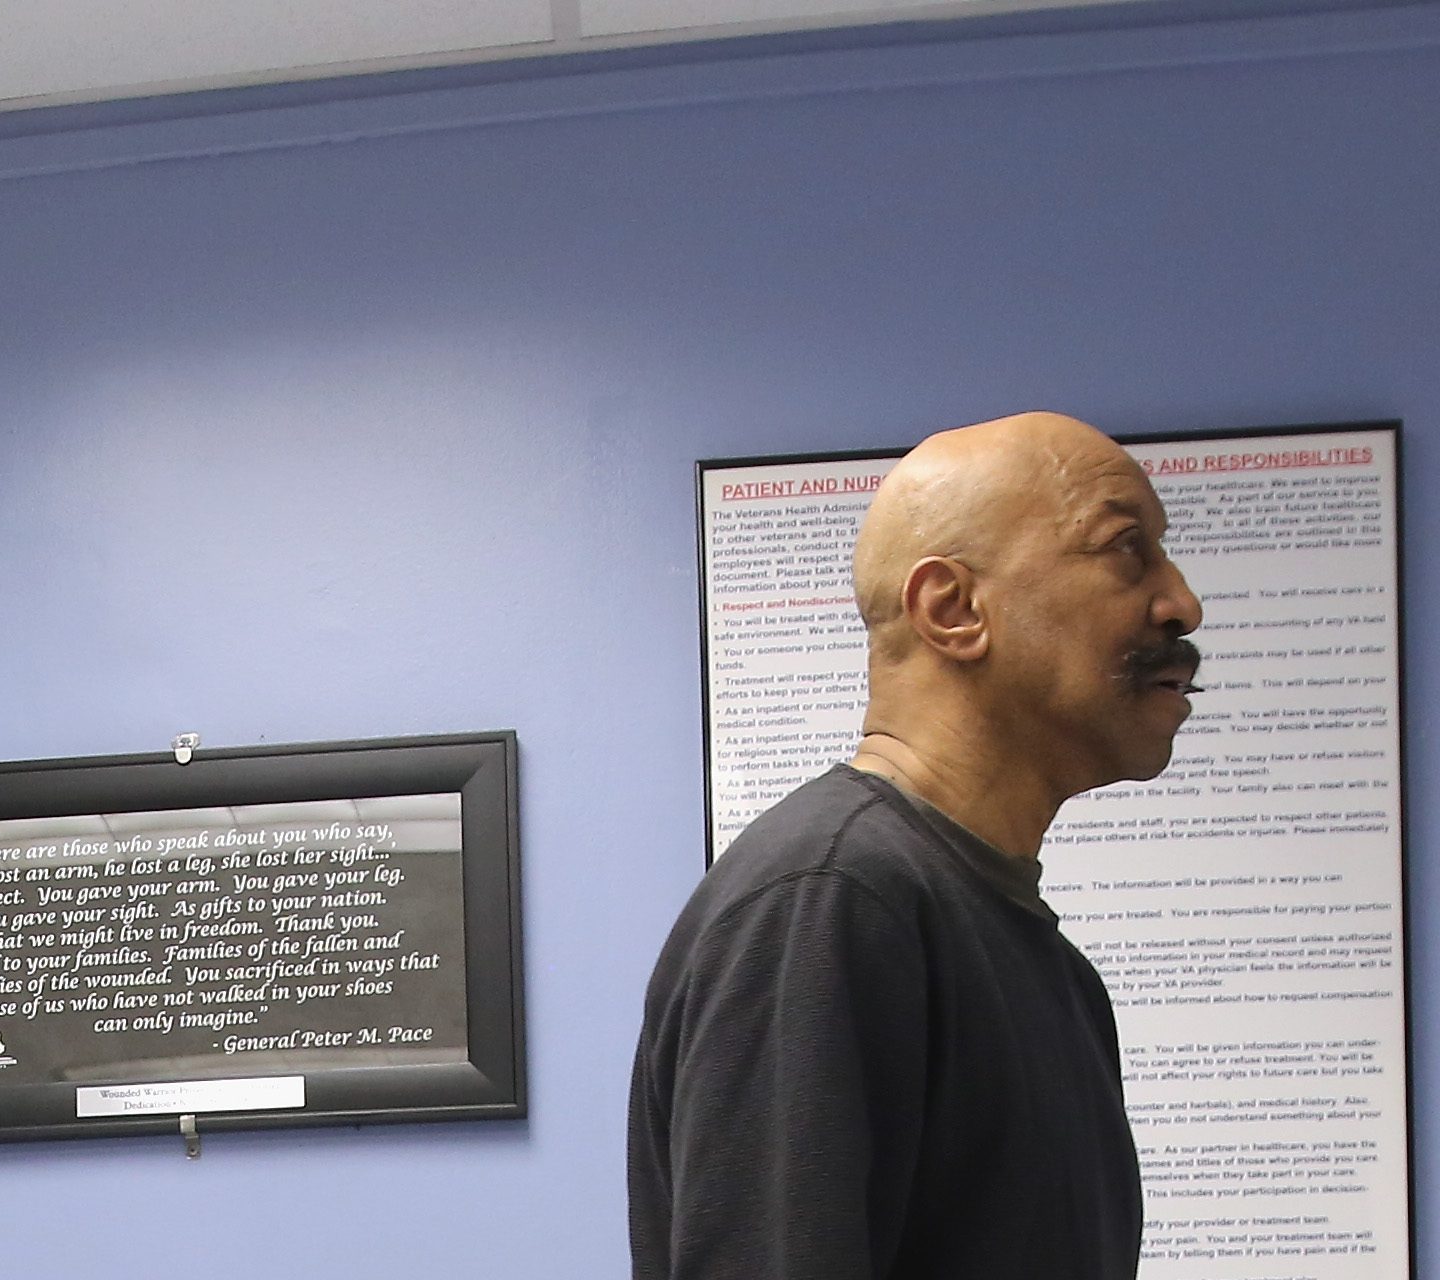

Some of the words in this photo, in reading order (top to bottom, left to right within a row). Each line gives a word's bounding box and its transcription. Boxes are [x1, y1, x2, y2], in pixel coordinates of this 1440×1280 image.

[1160, 456, 1197, 473] AND
[1204, 446, 1373, 471] RESPONSIBILITIES
[722, 480, 794, 498] PATIENT
[799, 478, 837, 493] AND
[844, 474, 883, 489] NUR
[26, 845, 56, 858] are
[63, 838, 108, 856] those
[113, 834, 151, 852] who
[156, 830, 208, 855] speak
[213, 828, 266, 846] about
[272, 829, 306, 848] you
[311, 822, 350, 840] who
[355, 824, 392, 842] say,
[25, 868, 50, 881] an
[55, 865, 98, 879] arm,
[104, 858, 125, 876] he
[130, 856, 162, 874] lost
[167, 860, 180, 872] a
[185, 853, 215, 875] leg,
[220, 850, 250, 869] she
[256, 849, 288, 866] lost
[293, 846, 325, 864] her
[37, 886, 73, 905] You
[76, 885, 121, 905] gave
[126, 882, 172, 902] your
[176, 879, 219, 893] arm.
[232, 874, 269, 893] You
[272, 873, 318, 893] gave
[323, 870, 369, 890] your
[374, 863, 404, 886] leg.
[10, 911, 56, 931] gave
[61, 908, 106, 928] your
[109, 900, 158, 920] sight.
[170, 900, 196, 916] As
[199, 895, 242, 920] gifts
[247, 897, 265, 911] to
[271, 895, 316, 916] your
[320, 889, 386, 907] nation.
[27, 934, 54, 946] we
[59, 925, 114, 945] might
[124, 925, 153, 941] live
[159, 923, 179, 939] in
[178, 917, 262, 944] freedom.
[274, 911, 334, 932] Thank
[339, 914, 378, 934] you.
[3, 956, 20, 970] to
[25, 955, 71, 975] your
[72, 946, 151, 972] families.
[162, 940, 242, 964] Families
[247, 937, 269, 961] of
[271, 936, 299, 954] the
[300, 933, 358, 958] fallen
[363, 929, 404, 949] and
[27, 973, 48, 996] of
[51, 971, 78, 990] the
[83, 965, 172, 987] wounded.
[184, 966, 220, 985] You
[224, 957, 320, 980] sacrificed
[321, 958, 340, 974] in
[345, 958, 394, 977] ways
[400, 951, 439, 969] that
[21, 995, 42, 1019] of
[43, 999, 64, 1012] us
[69, 992, 107, 1010] who
[112, 990, 157, 1008] have
[162, 990, 194, 1005] not
[198, 982, 271, 1003] walked
[271, 983, 290, 999] in
[295, 983, 341, 1004] your
[344, 977, 393, 995] shoes
[93, 1018, 128, 1032] can
[132, 1010, 173, 1034] only
[223, 1029, 300, 1054] General
[300, 1031, 352, 1046] Peter
[356, 1027, 381, 1043] M.
[387, 1026, 432, 1042] Pace
[100, 1088, 140, 1099] Wounded
